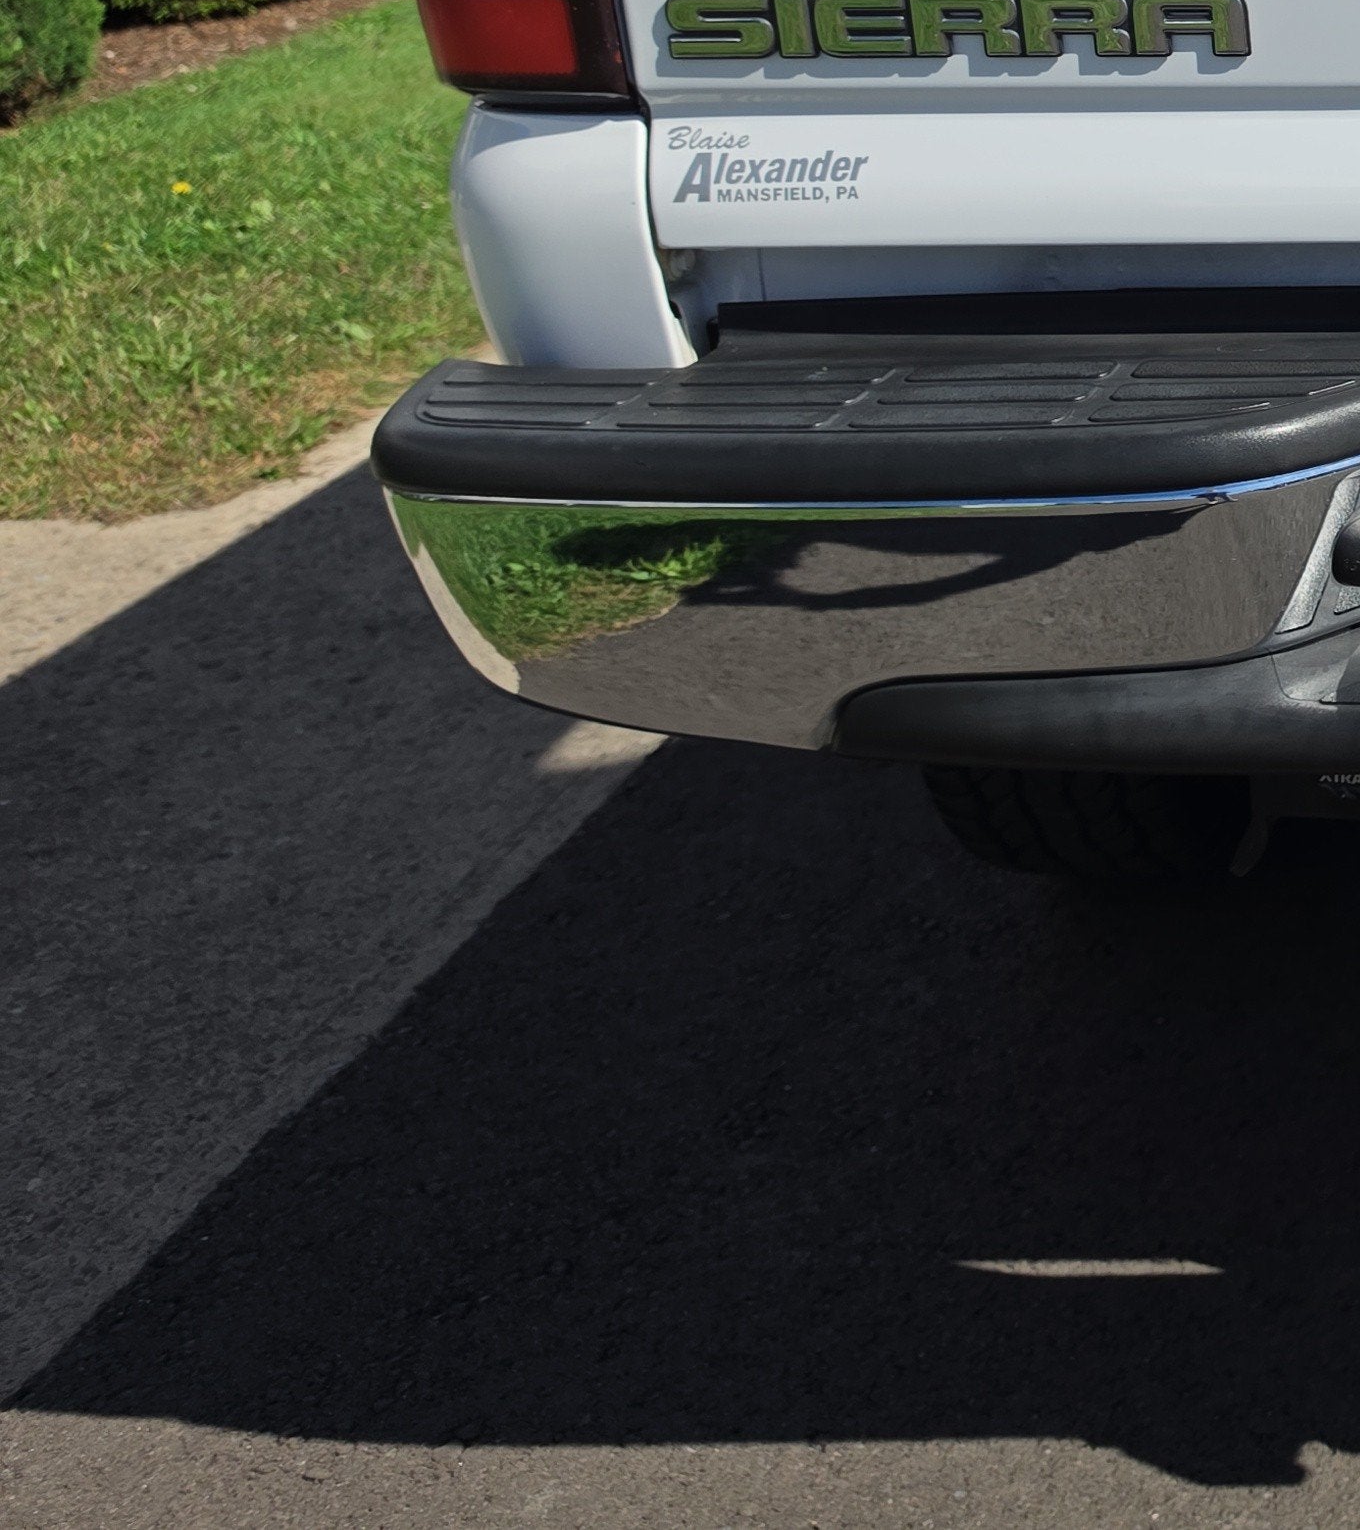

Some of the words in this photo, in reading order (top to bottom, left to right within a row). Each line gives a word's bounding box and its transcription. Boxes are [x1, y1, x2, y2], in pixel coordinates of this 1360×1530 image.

[667, 126, 749, 150] Blaise
[673, 150, 869, 203] Alexander
[717, 187, 830, 203] MANSFIELD,
[836, 186, 859, 200] PA
